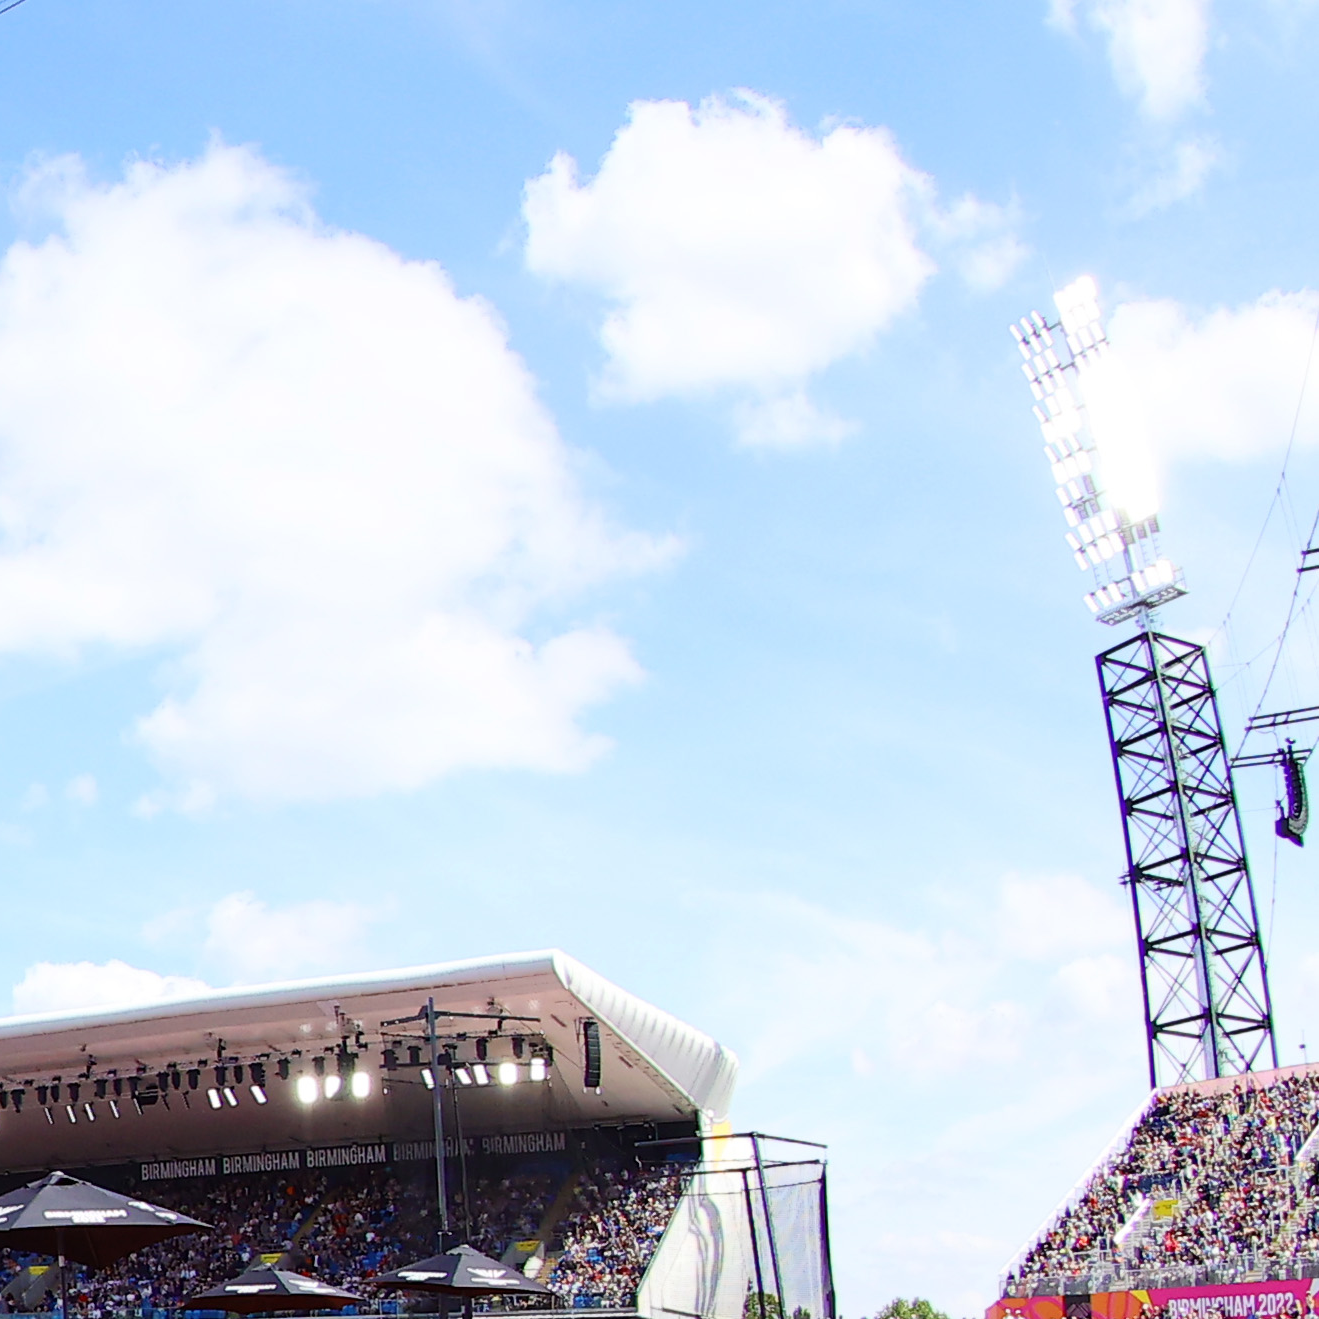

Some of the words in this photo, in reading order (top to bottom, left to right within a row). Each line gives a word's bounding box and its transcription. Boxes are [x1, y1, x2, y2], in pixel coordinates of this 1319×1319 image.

[141, 1158, 216, 1181] BIRMINGHAM
[222, 1152, 301, 1174] BIRMINGHAM
[306, 1144, 387, 1168] BIRMINGHAM
[482, 1132, 566, 1154] BIRMINGHAM
[1258, 1292, 1294, 1316] 2022
